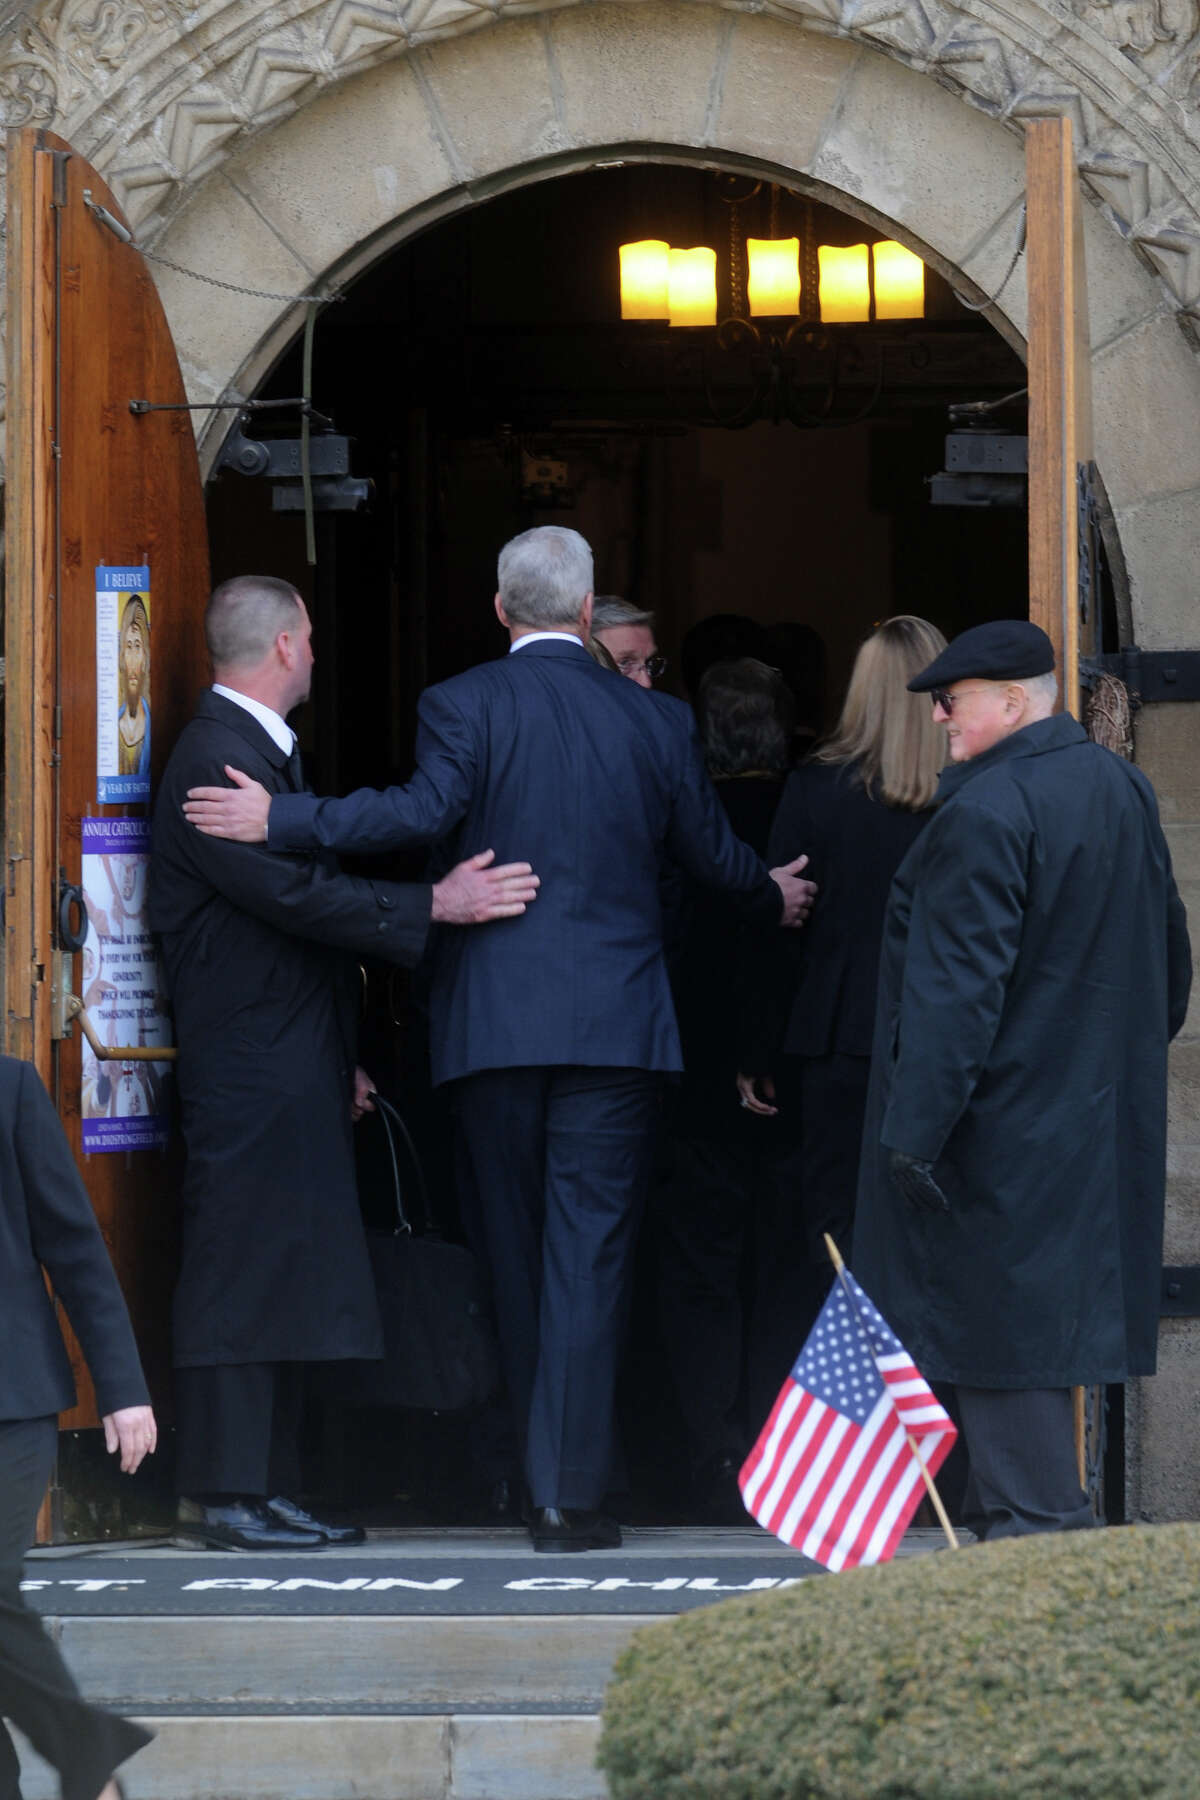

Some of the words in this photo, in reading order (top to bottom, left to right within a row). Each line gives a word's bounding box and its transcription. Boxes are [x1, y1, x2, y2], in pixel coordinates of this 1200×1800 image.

[104, 573, 110, 588] I
[112, 573, 143, 588] BELIEVE
[106, 783, 122, 794] YEAR
[123, 783, 132, 793] OF
[133, 782, 151, 793] FAITH
[83, 822, 111, 837] ANNUAL
[180, 1577, 465, 1591] ANN
